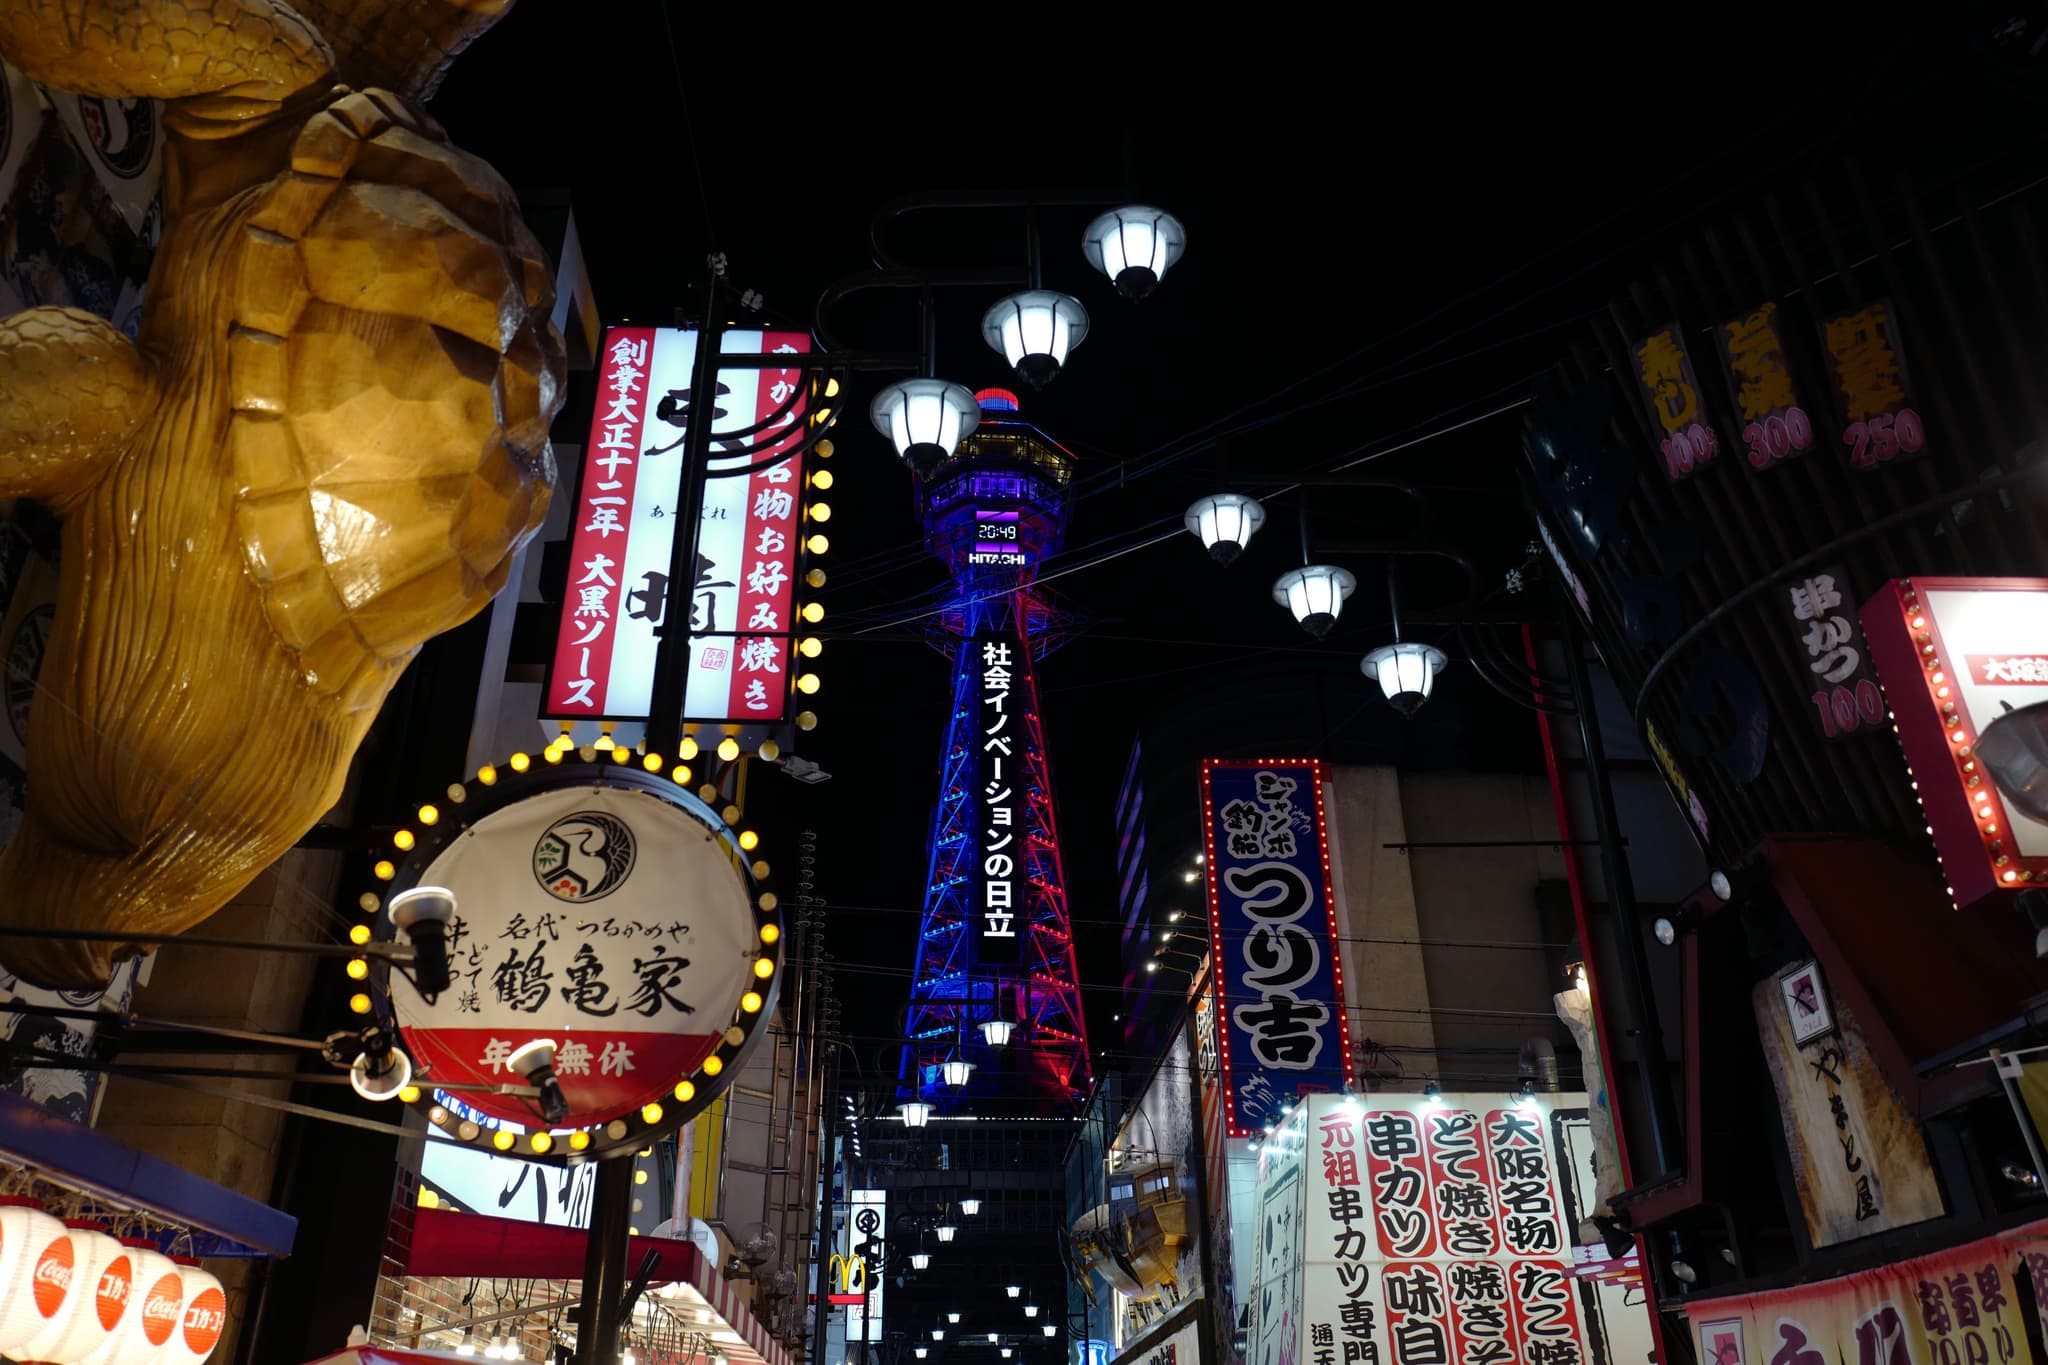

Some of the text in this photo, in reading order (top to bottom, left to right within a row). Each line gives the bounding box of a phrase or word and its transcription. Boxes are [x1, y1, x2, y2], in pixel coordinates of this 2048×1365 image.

[1742, 407, 1815, 471] 300
[1842, 407, 1926, 470] 250
[561, 337, 649, 708] 創業大正十二年 大黒ソース
[969, 553, 1026, 565] HITACHI
[978, 524, 1017, 540] 20:49
[1789, 573, 1860, 684] 串かつ
[1811, 678, 1884, 738] 100
[982, 642, 1015, 937] 社会イノベーションの日立
[1255, 771, 1297, 858] ジャンボ
[1222, 800, 1265, 858] 釣船
[576, 918, 690, 944] つるかめや
[1226, 863, 1328, 1067] つり吉
[455, 941, 489, 1014] どて焼
[490, 940, 696, 1018] 鶴亀家
[478, 1037, 636, 1078] 年無休
[1367, 1115, 1427, 1254] 串カツ
[1432, 1113, 1492, 1254] どて焼き
[1491, 1113, 1557, 1251] 大阪名物
[1516, 1265, 1580, 1365] たこ焼
